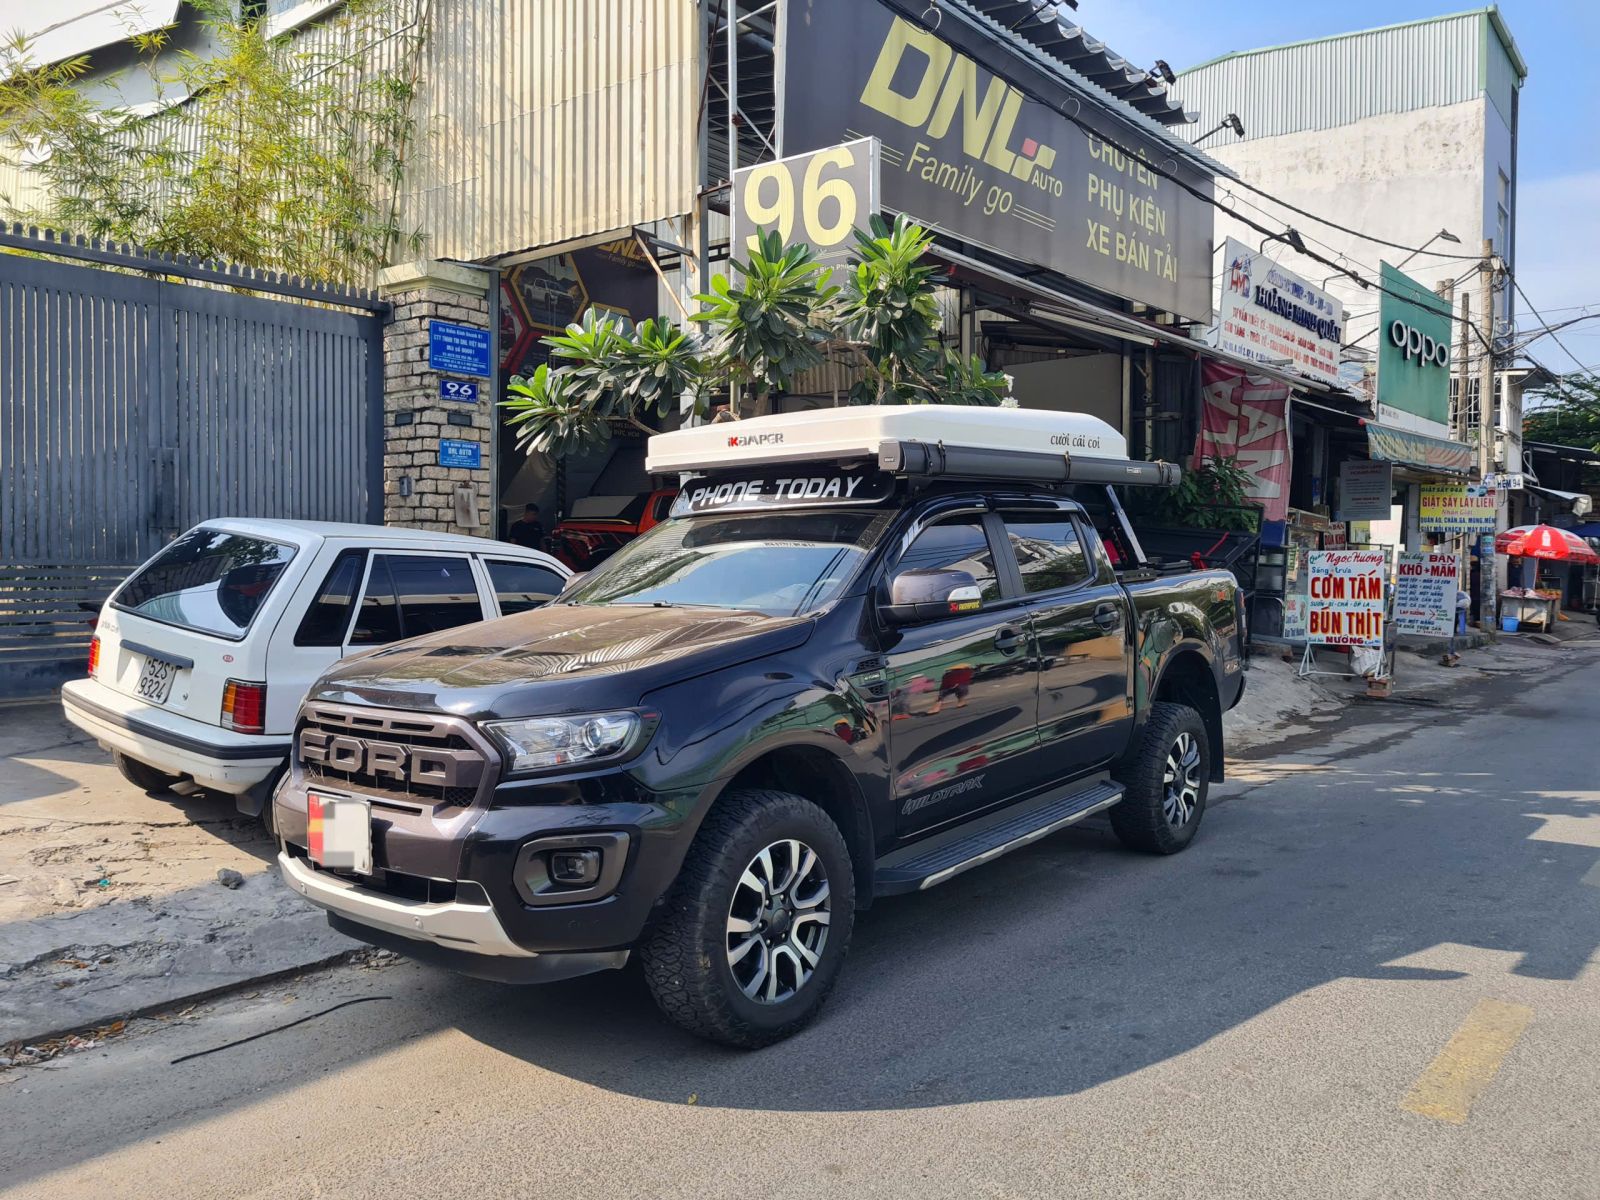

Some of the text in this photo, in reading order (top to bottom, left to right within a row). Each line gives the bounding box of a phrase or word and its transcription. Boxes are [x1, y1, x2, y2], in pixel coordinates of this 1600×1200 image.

[860, 15, 1017, 174] DNL
[906, 142, 1013, 215] Family go
[1032, 170, 1063, 197] AUTO
[744, 147, 857, 254] 96
[1088, 173, 1166, 236] PHỤ KIỆN
[1086, 219, 1177, 283] XE BÁN TẢI
[446, 382, 472, 396] 96
[1050, 433, 1070, 446] cười
[689, 475, 864, 509] PHONE TODAY
[1512, 478, 1521, 487] 94
[1311, 569, 1382, 600] CƠM TẤM
[1310, 606, 1382, 640] BÚN THỊT
[148, 659, 171, 681] 52S
[138, 677, 167, 701] 9324
[300, 729, 470, 787] FORD
